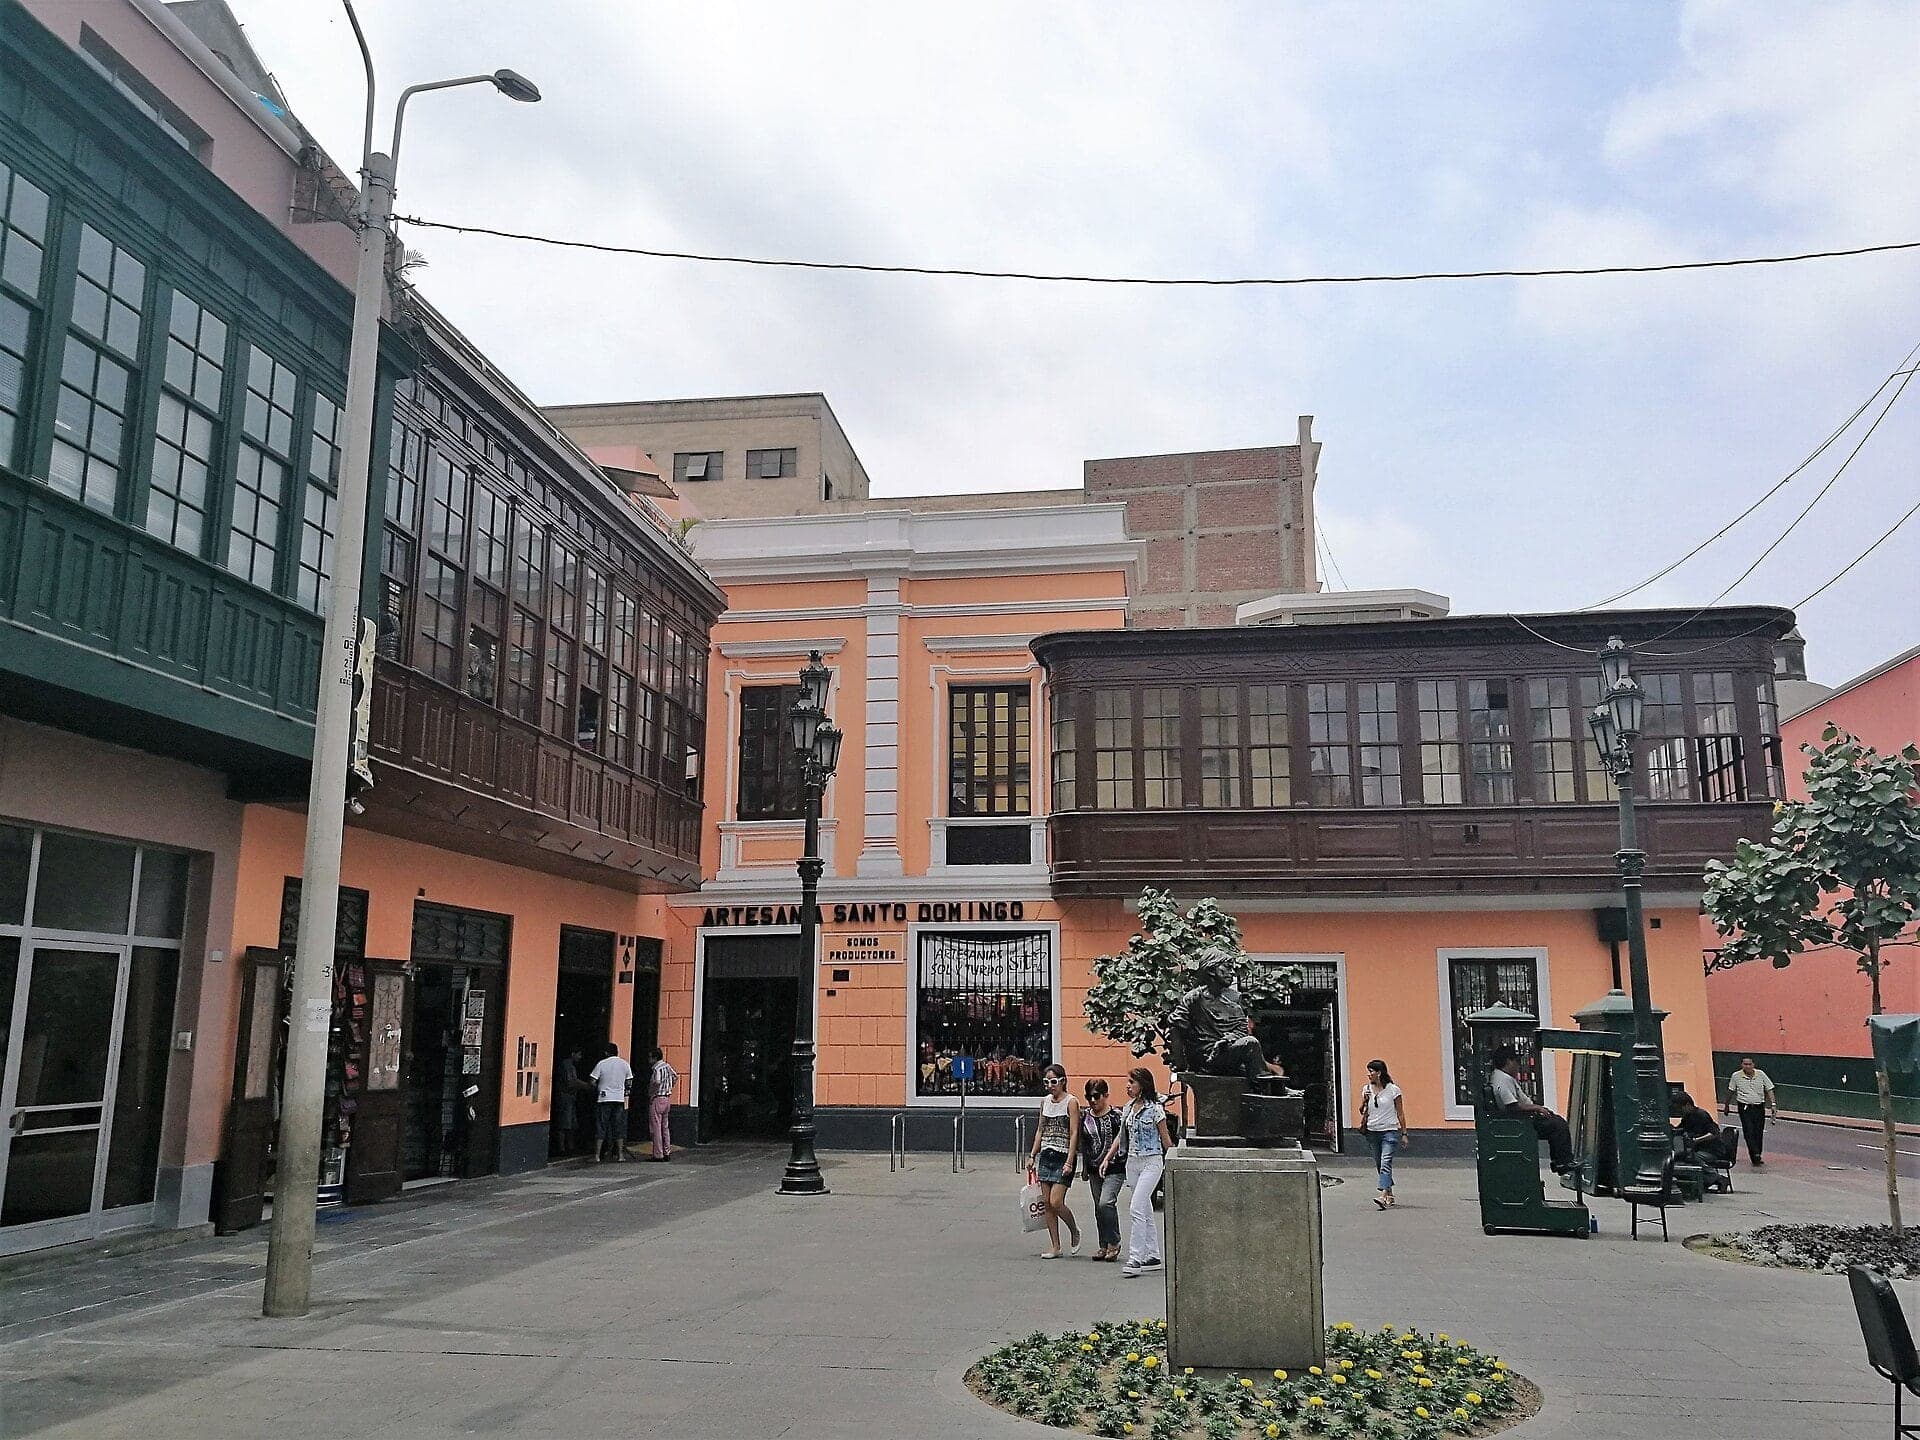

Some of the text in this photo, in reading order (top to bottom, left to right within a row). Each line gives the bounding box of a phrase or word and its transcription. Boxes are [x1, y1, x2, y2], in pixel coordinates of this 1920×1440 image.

[702, 900, 1024, 926] ARTESANA SANTO DOMINGO
[847, 937, 879, 947] SOMOS
[829, 950, 896, 961] PRODUCTORES
